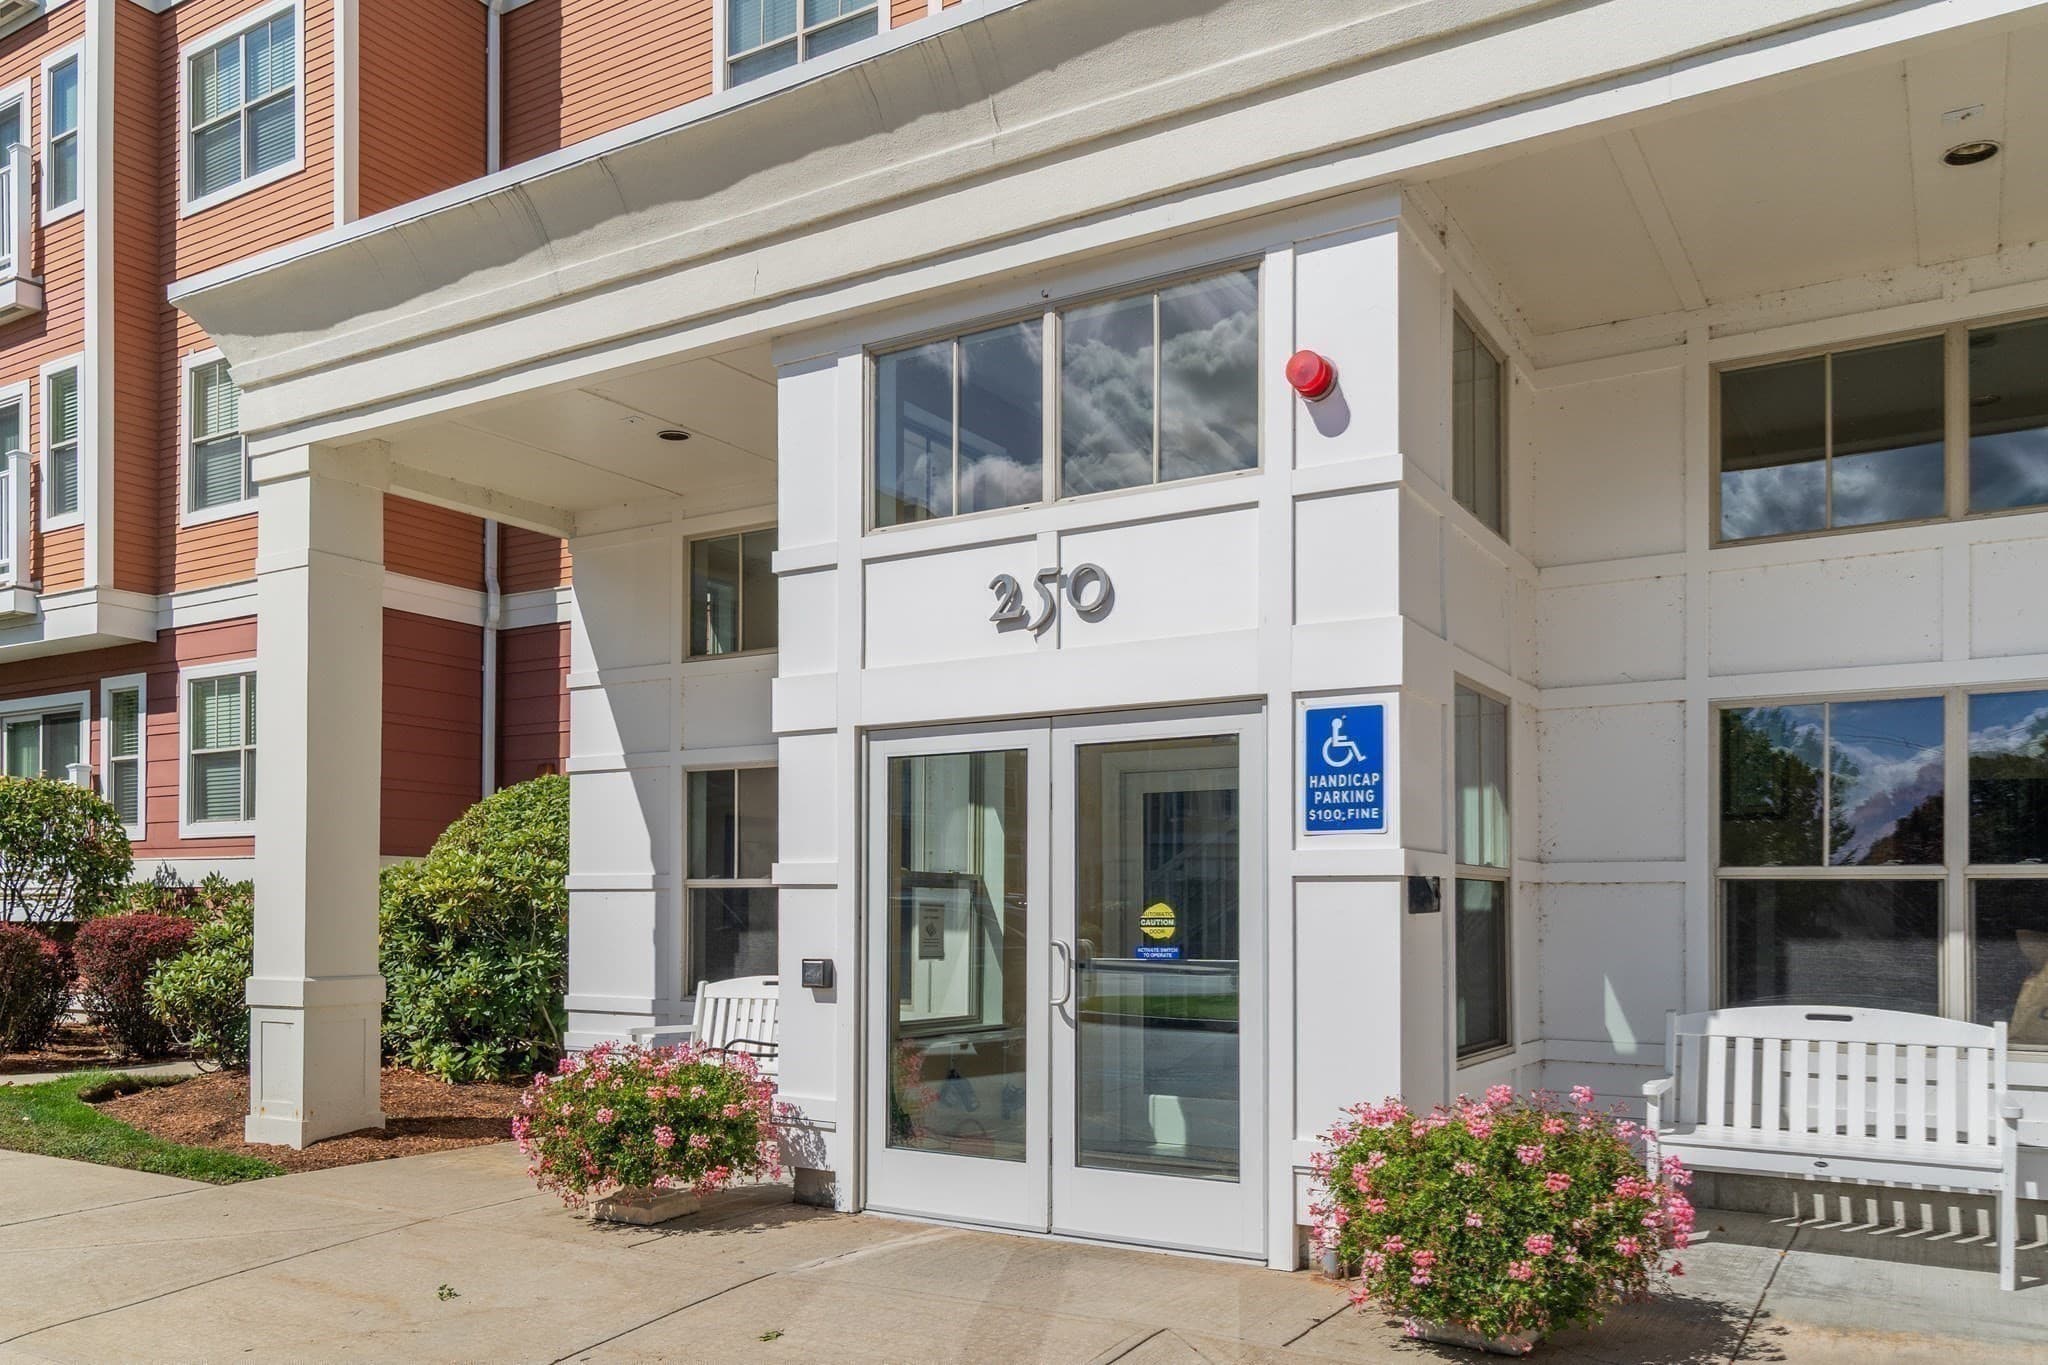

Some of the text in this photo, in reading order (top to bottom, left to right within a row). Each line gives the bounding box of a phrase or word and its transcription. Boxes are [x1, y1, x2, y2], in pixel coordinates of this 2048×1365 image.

[988, 562, 1111, 632] 250
[1309, 773, 1380, 788] HANDICAP
[1314, 790, 1375, 804] PARKING
[1347, 808, 1379, 819] FINE
